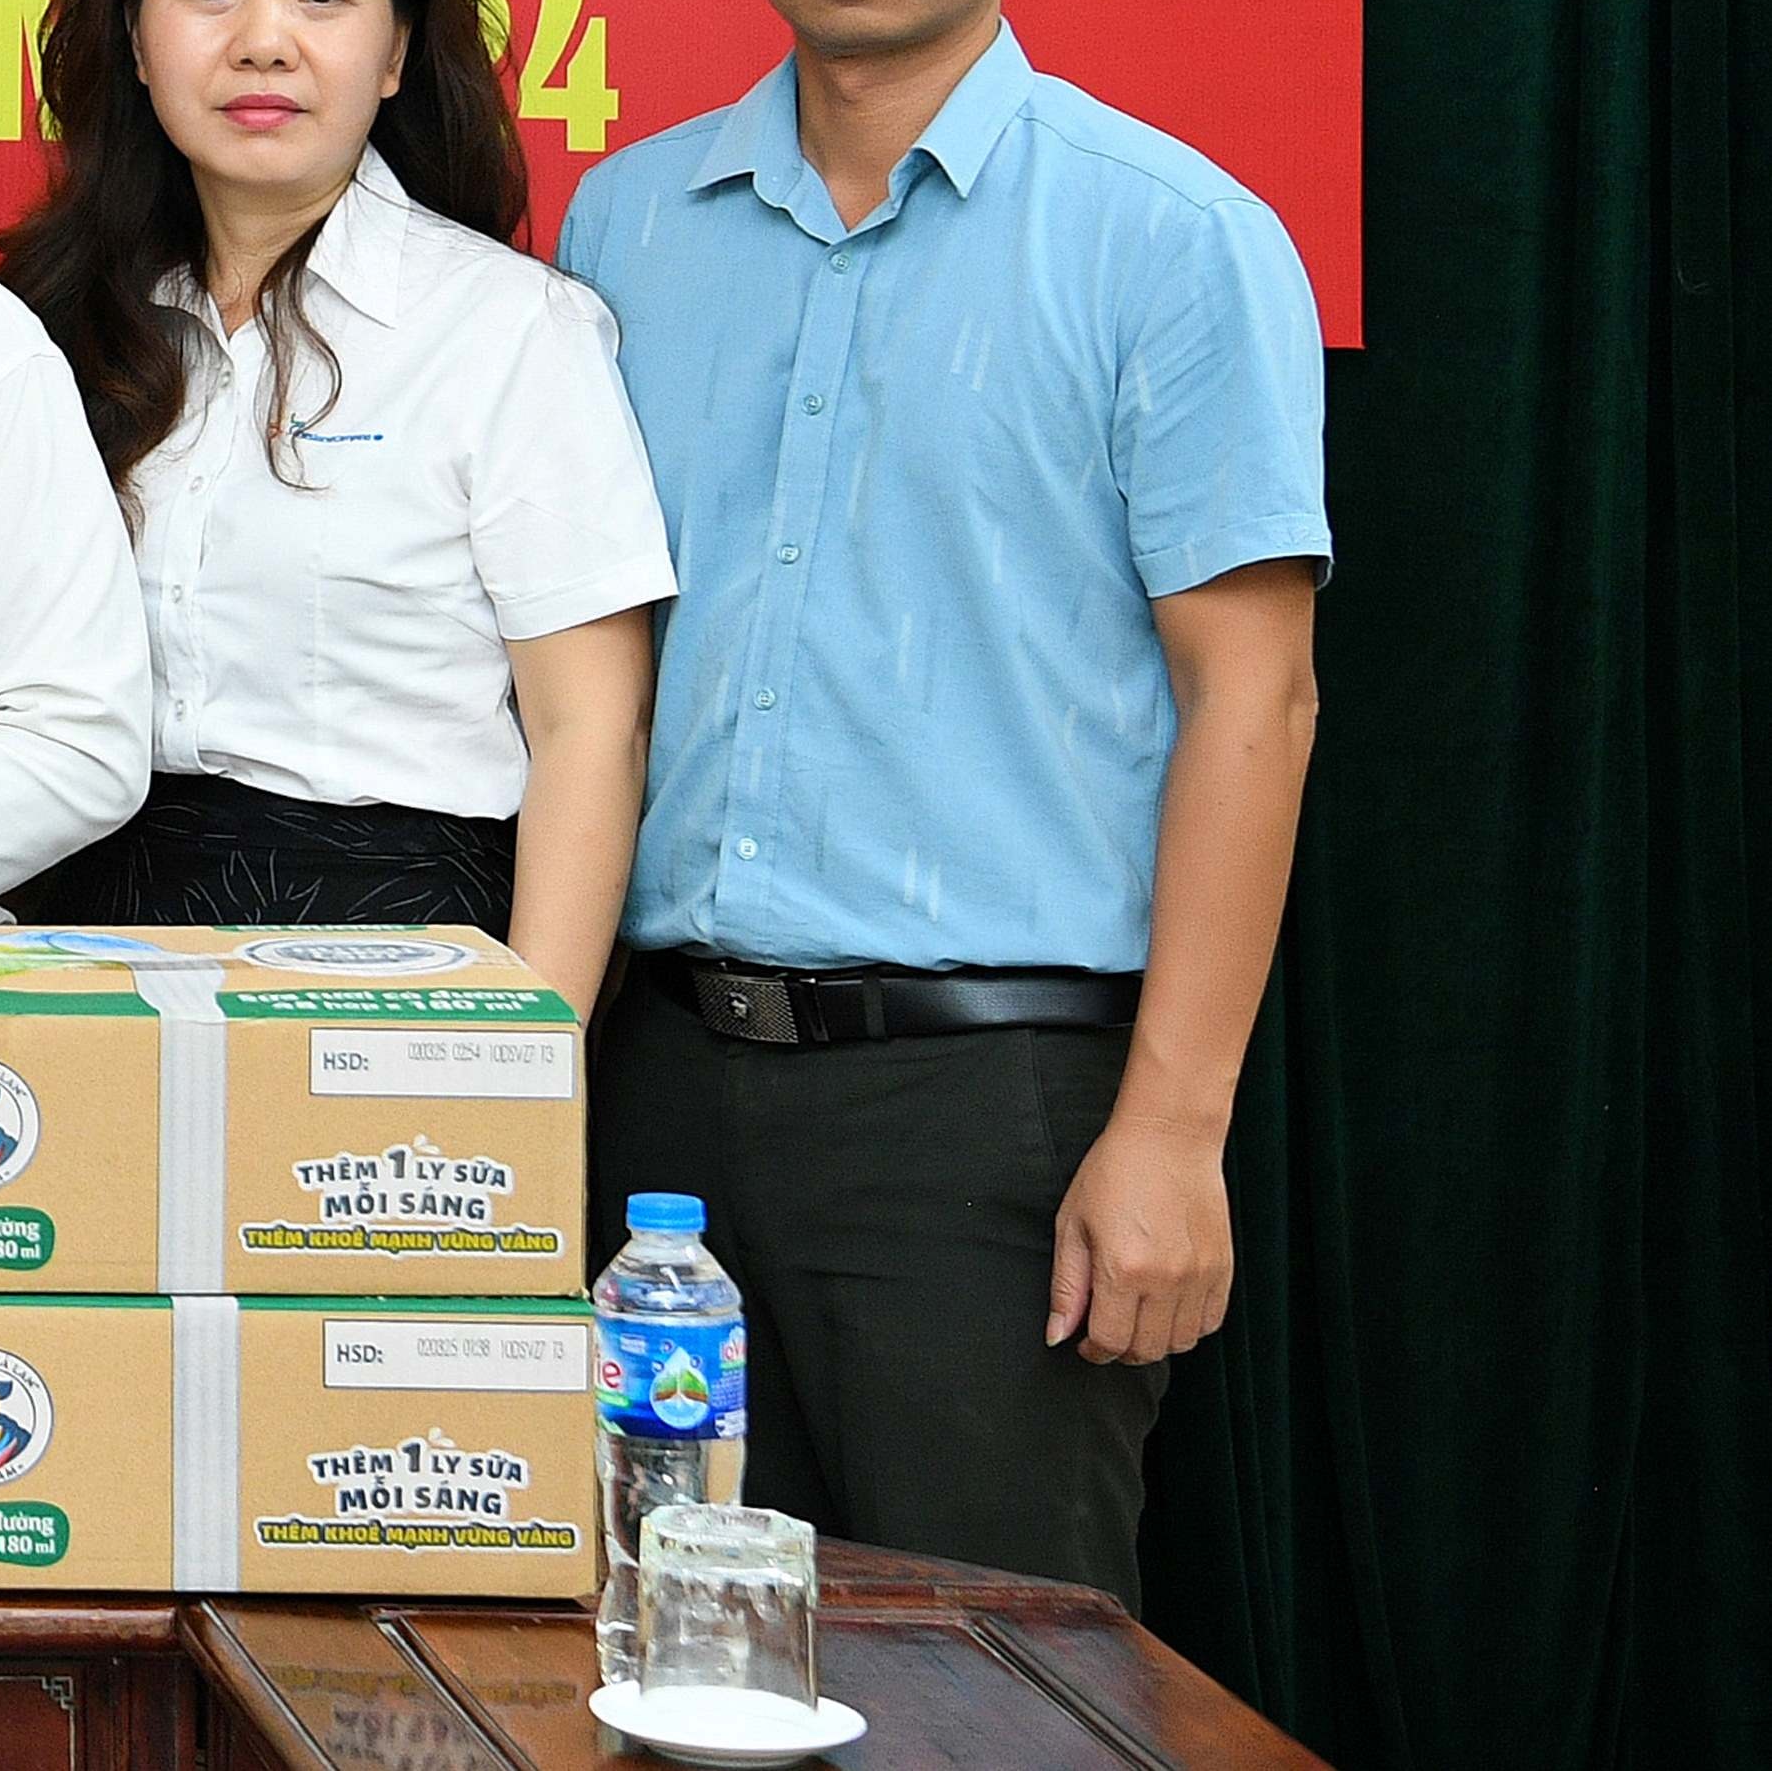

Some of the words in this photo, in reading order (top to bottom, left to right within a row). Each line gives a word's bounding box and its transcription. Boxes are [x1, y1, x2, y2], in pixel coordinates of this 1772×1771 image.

[297, 1158, 378, 1185] THÊM
[387, 1150, 406, 1179] 1
[416, 1162, 446, 1181] LY
[454, 1161, 507, 1188] SỮA
[324, 1183, 388, 1218] MỖI
[399, 1188, 486, 1220] SÁNG
[312, 1451, 393, 1478] THÊM
[402, 1443, 422, 1473] 1
[431, 1456, 461, 1475] LY
[470, 1454, 522, 1482] SỮA
[339, 1477, 403, 1513] MỖI
[414, 1482, 502, 1515] SÁNG
